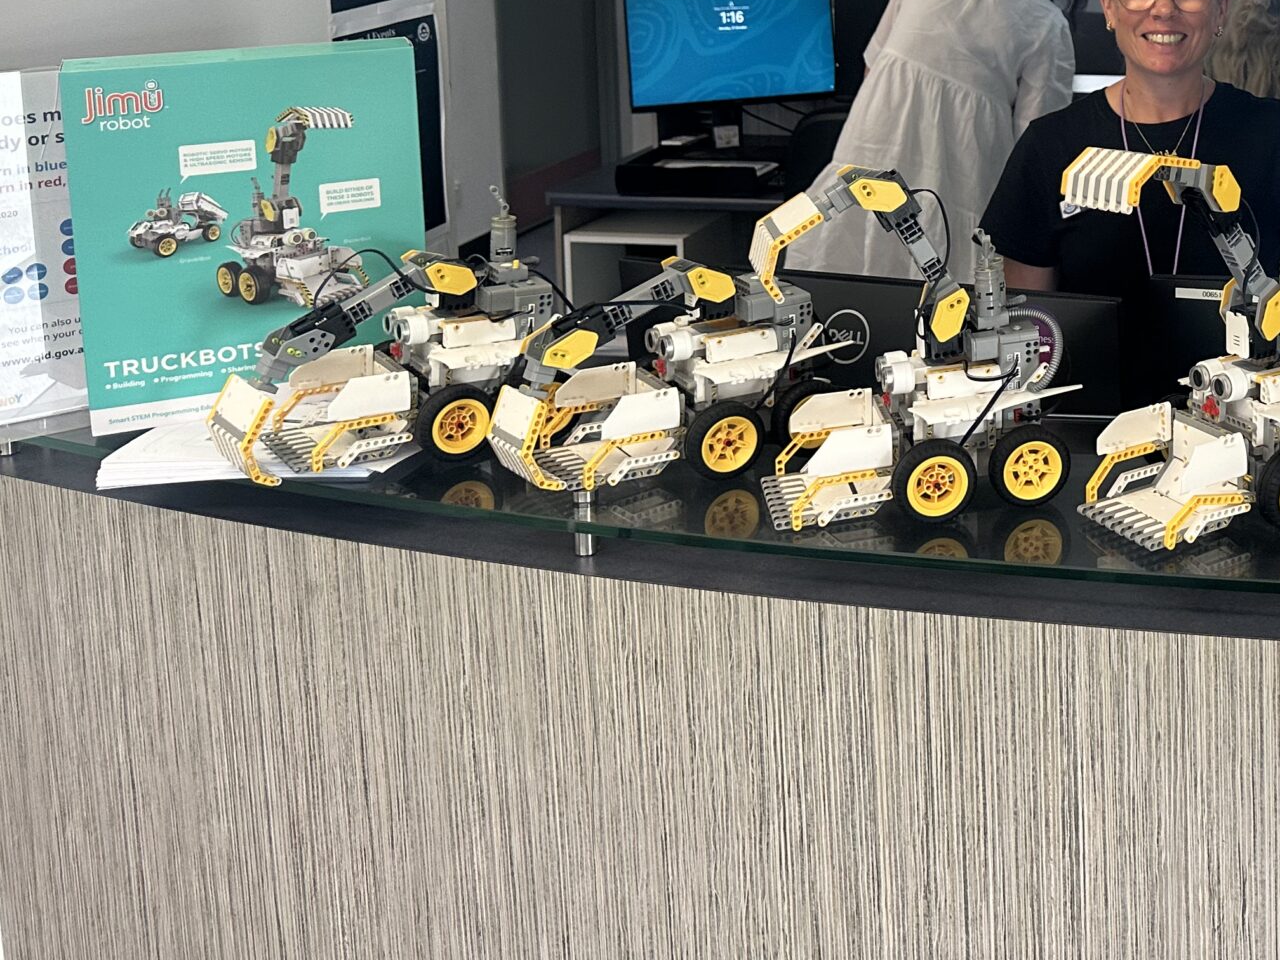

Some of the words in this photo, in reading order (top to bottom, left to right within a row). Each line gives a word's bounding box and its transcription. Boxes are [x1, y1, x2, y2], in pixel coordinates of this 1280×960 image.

[720, 10, 744, 24] 1:16
[100, 115, 151, 131] robot
[28, 134, 49, 146] or
[35, 160, 67, 172] blue
[38, 176, 66, 189] red,
[0, 210, 18, 219] 020
[51, 318, 72, 328] also
[52, 329, 76, 341] your
[829, 329, 864, 344] DELL
[112, 379, 145, 389] Building
[160, 370, 213, 383] Programming
[228, 363, 256, 373] Sharing
[109, 416, 130, 425] Smart
[132, 413, 151, 422] STEM
[152, 407, 199, 418] Programming
